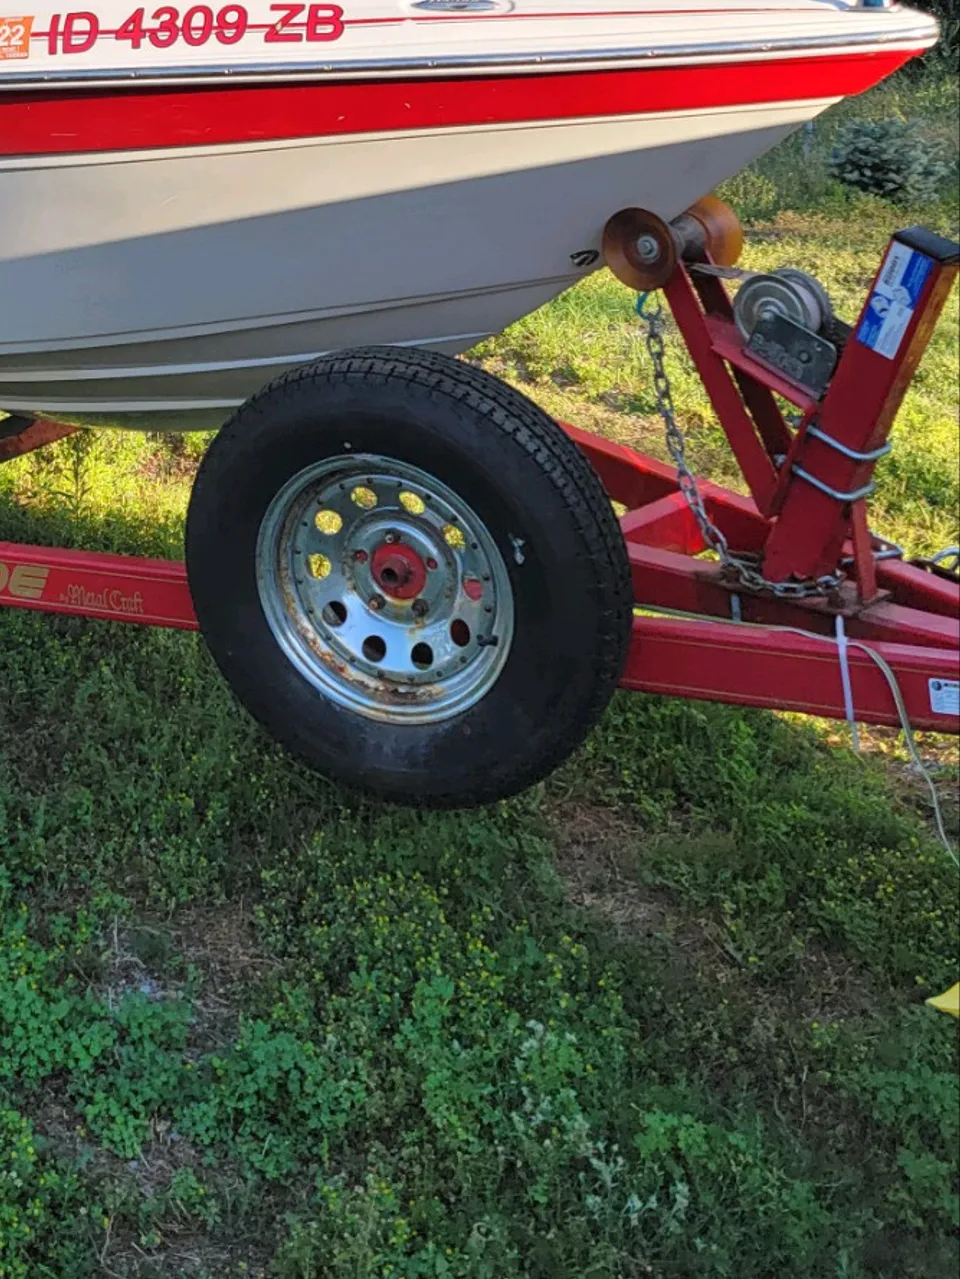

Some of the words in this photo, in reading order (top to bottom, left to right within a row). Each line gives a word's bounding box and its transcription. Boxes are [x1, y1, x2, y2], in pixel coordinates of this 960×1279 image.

[47, 11, 100, 56] ID
[115, 3, 249, 50] 4309
[264, 3, 345, 43] ZB
